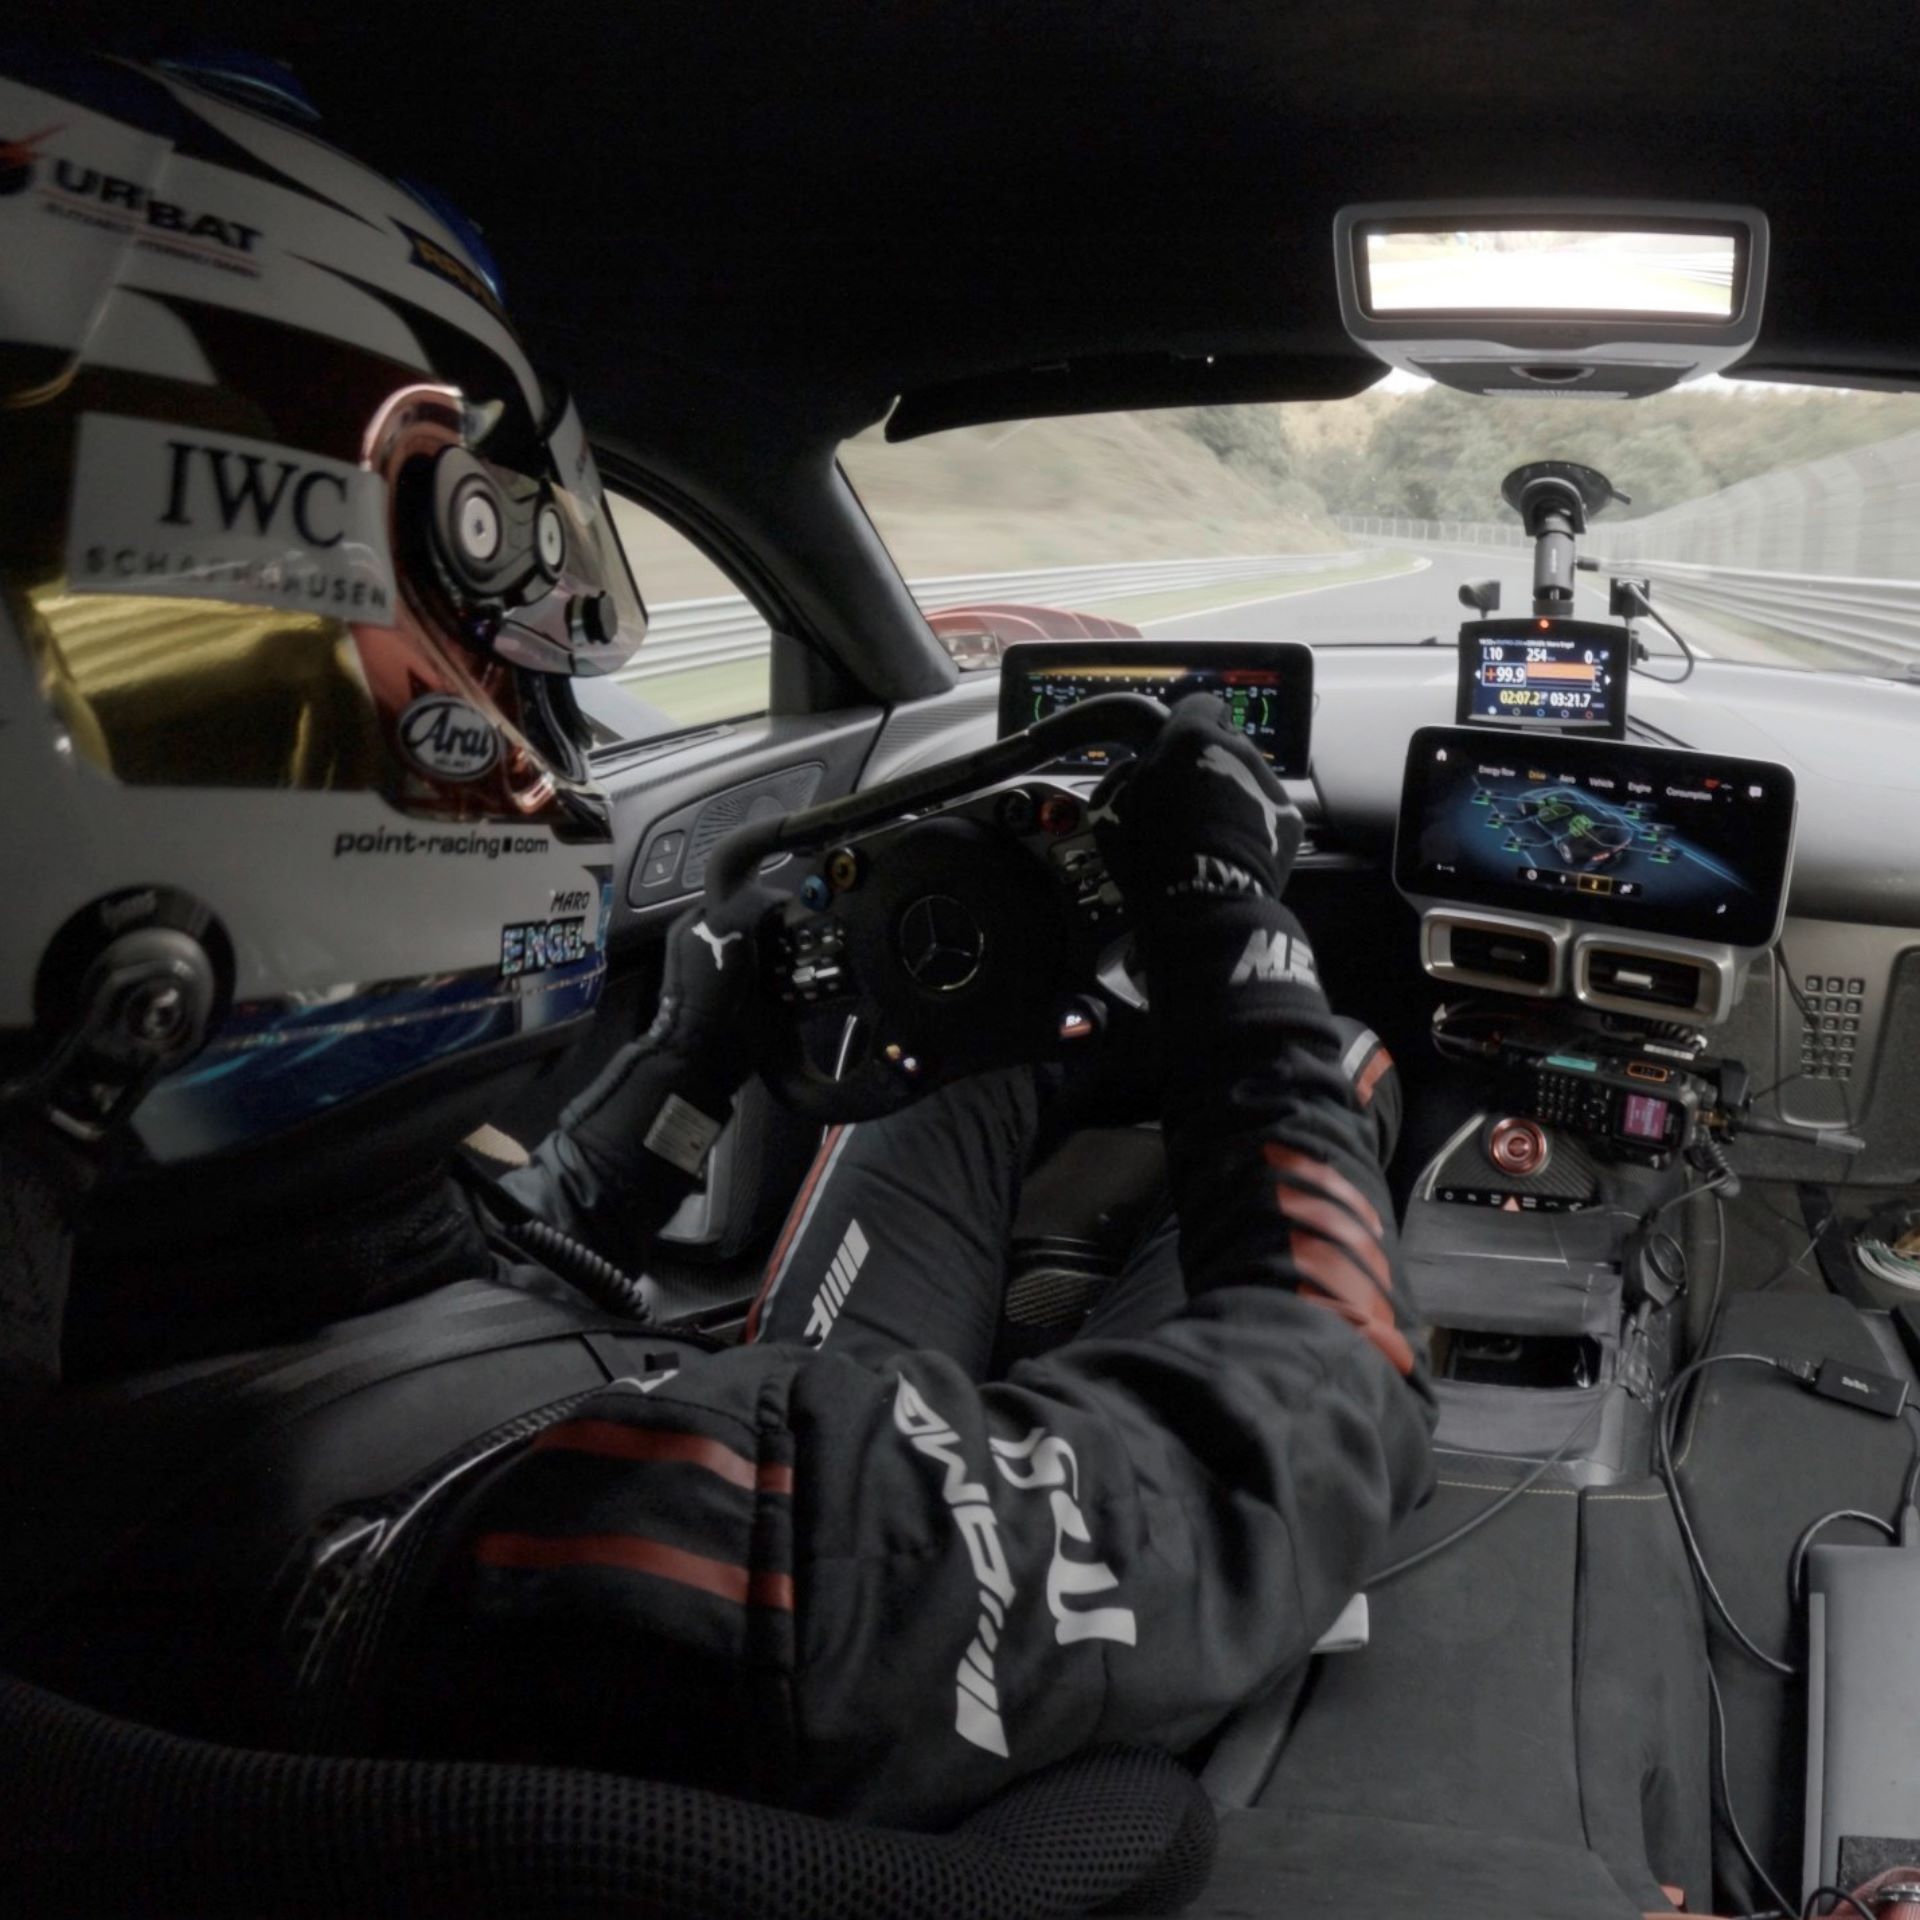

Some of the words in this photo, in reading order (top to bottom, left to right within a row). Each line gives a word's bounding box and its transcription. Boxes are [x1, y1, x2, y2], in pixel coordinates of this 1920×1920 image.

[55, 159, 264, 252] URBAT
[158, 440, 348, 548] IWC
[85, 547, 388, 607] SCHAFAUSEN
[1526, 648, 1547, 661] 254
[405, 703, 493, 758] Arai
[1627, 782, 1653, 794] Engine
[1665, 786, 1713, 801] Consumption
[551, 891, 591, 912] MARO
[502, 919, 586, 977] ENGEL
